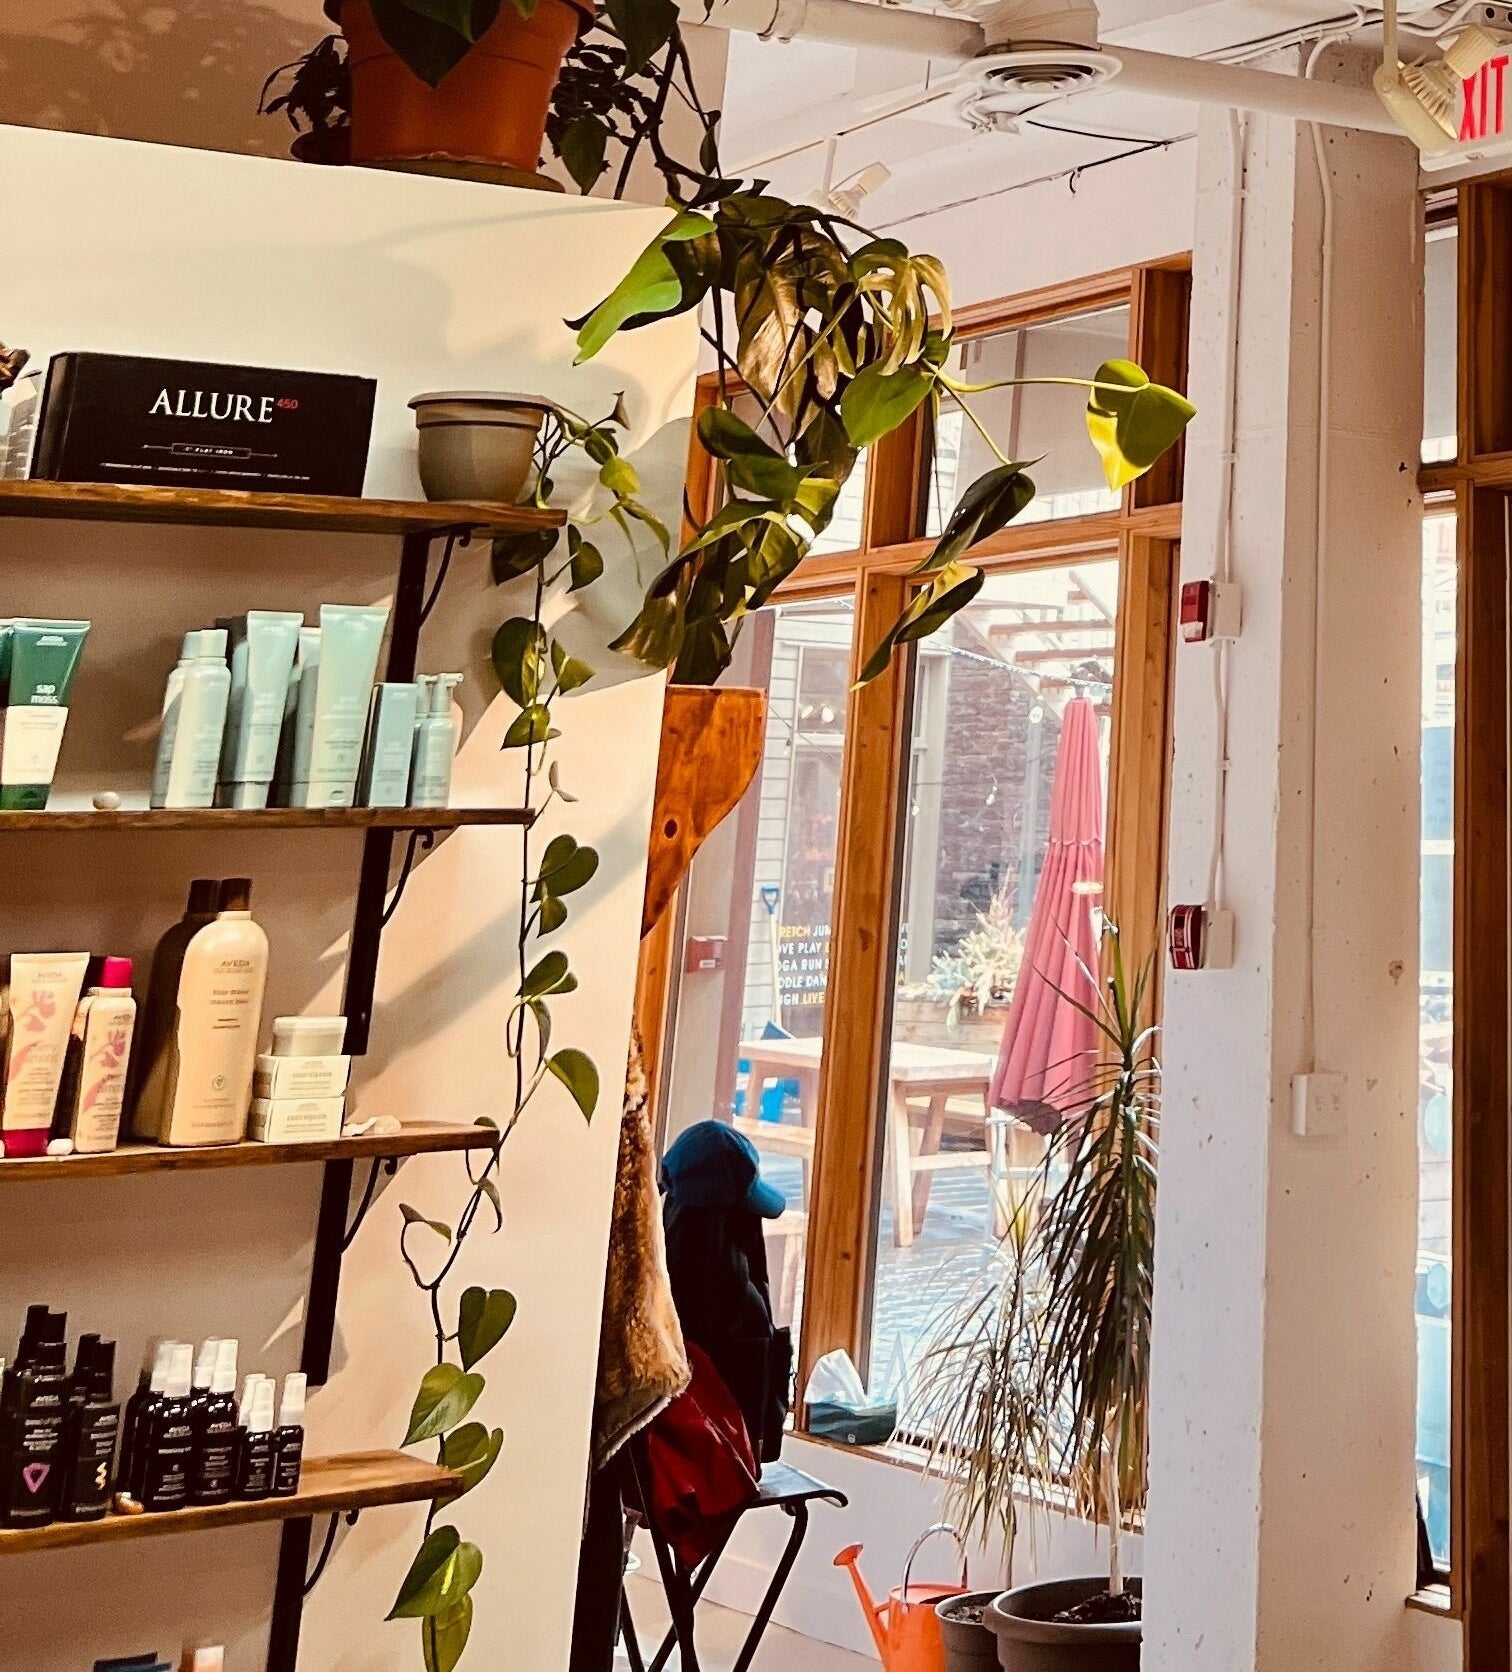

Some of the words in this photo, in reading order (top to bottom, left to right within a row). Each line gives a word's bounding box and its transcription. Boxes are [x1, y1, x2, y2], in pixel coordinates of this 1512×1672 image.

[1459, 55, 1509, 142] XIT
[149, 388, 275, 424] ALLURE
[277, 398, 299, 409] 450
[36, 684, 56, 695] sap
[30, 694, 59, 704] moss
[781, 926, 811, 938] RETCH
[798, 942, 822, 954] PLAY
[801, 959, 823, 971] RUN
